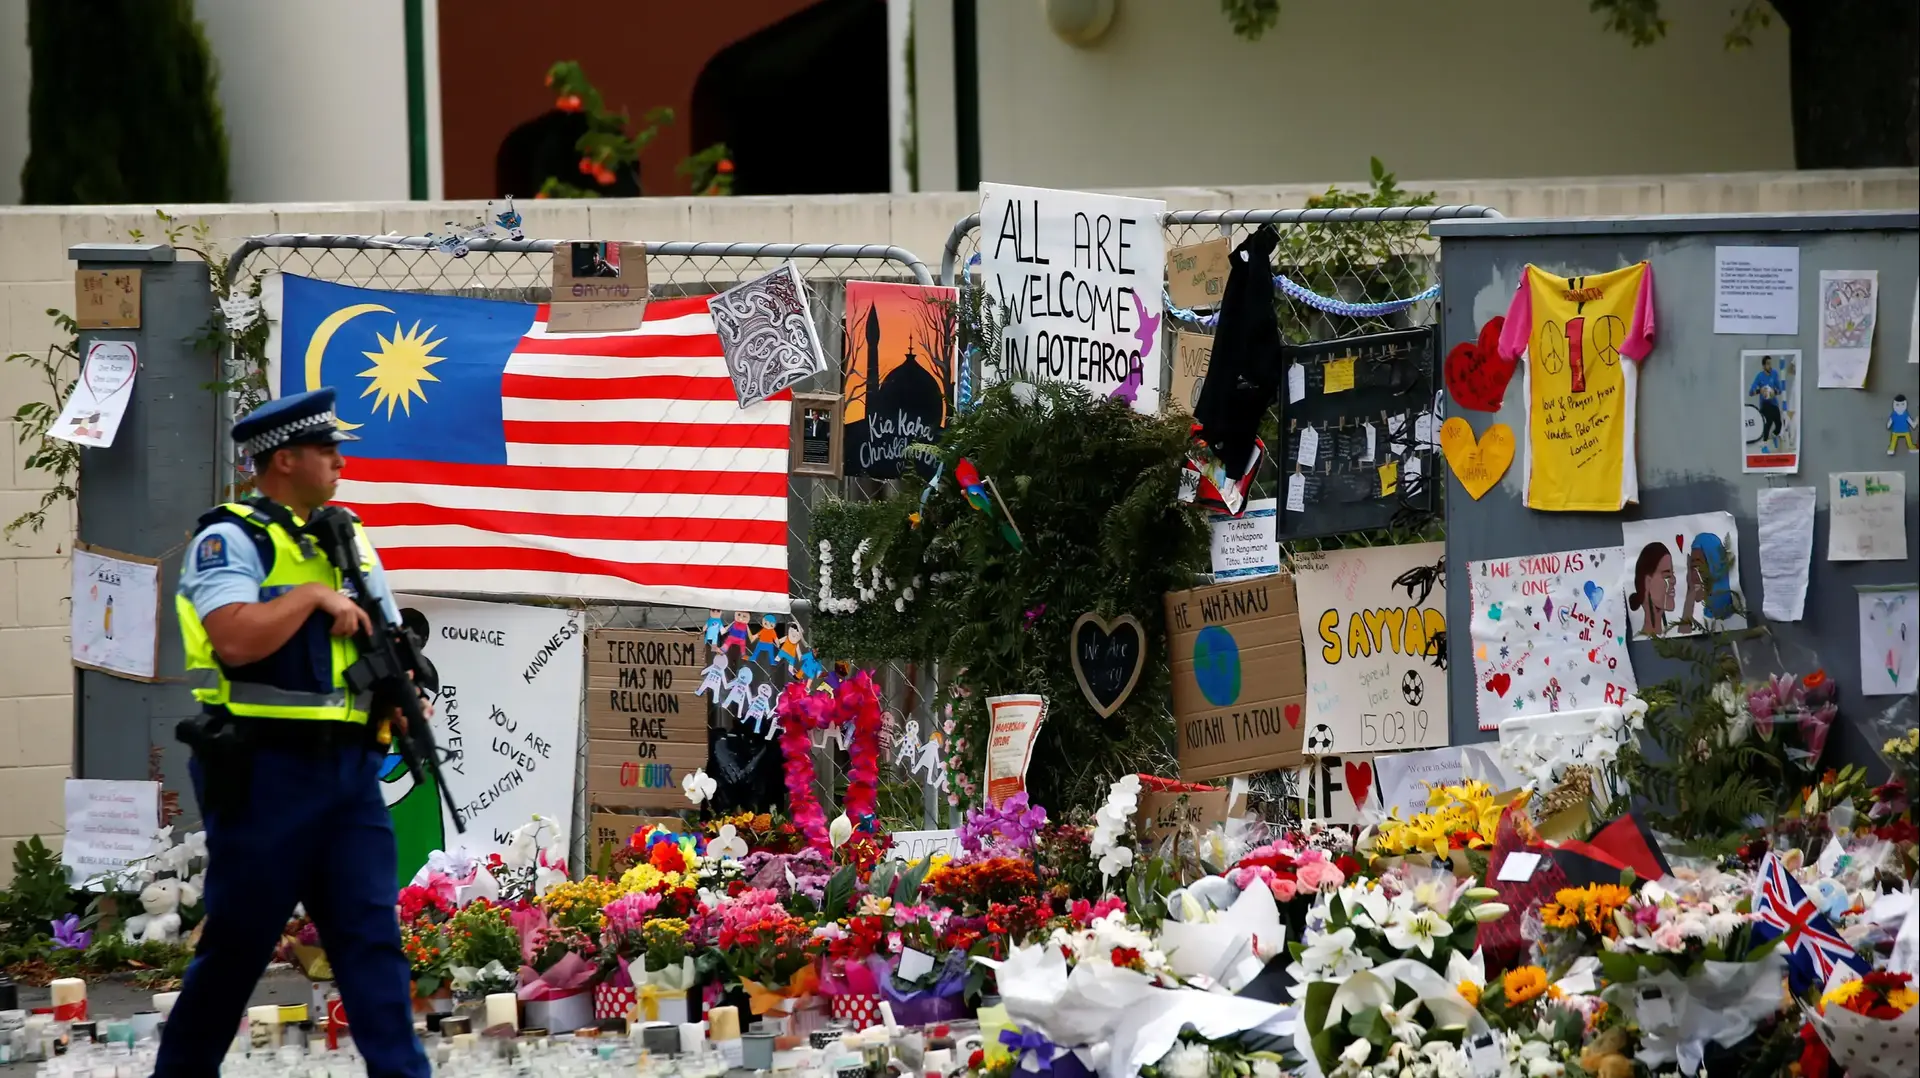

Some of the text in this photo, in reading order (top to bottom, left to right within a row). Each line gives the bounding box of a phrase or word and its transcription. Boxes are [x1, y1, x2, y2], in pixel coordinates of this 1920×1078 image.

[995, 199, 1136, 275] ALL ARE
[997, 270, 1134, 334] WELCOME
[1005, 330, 1144, 385] IN AOTEAROA
[1565, 317, 1586, 393] 1
[868, 408, 934, 443] Kia Kaha
[1222, 535, 1229, 543] Te
[1228, 521, 1255, 530] Te Aroha
[1490, 553, 1584, 578] WE STAND AS
[1522, 577, 1556, 597] ONE
[1174, 585, 1269, 630] HE WHĀNAU
[1570, 602, 1613, 639] Love To
[441, 626, 506, 646] COURAGE
[522, 619, 579, 685] KINDNESS
[607, 640, 695, 666] TERRORISM
[1318, 606, 1447, 665] SAYYAD
[619, 667, 673, 690] HAS NO
[610, 690, 679, 713] RELIGION
[441, 685, 465, 775] BRAVERY
[489, 704, 552, 759] YOU ARE
[630, 718, 668, 739] RACE
[1185, 705, 1281, 750] KOTAHI TATOU
[492, 737, 536, 772] LOVED
[638, 741, 657, 759] OR
[1408, 761, 1462, 773] We are in Solida
[619, 761, 676, 788] COLOUR.
[456, 768, 524, 826] STRENGTH
